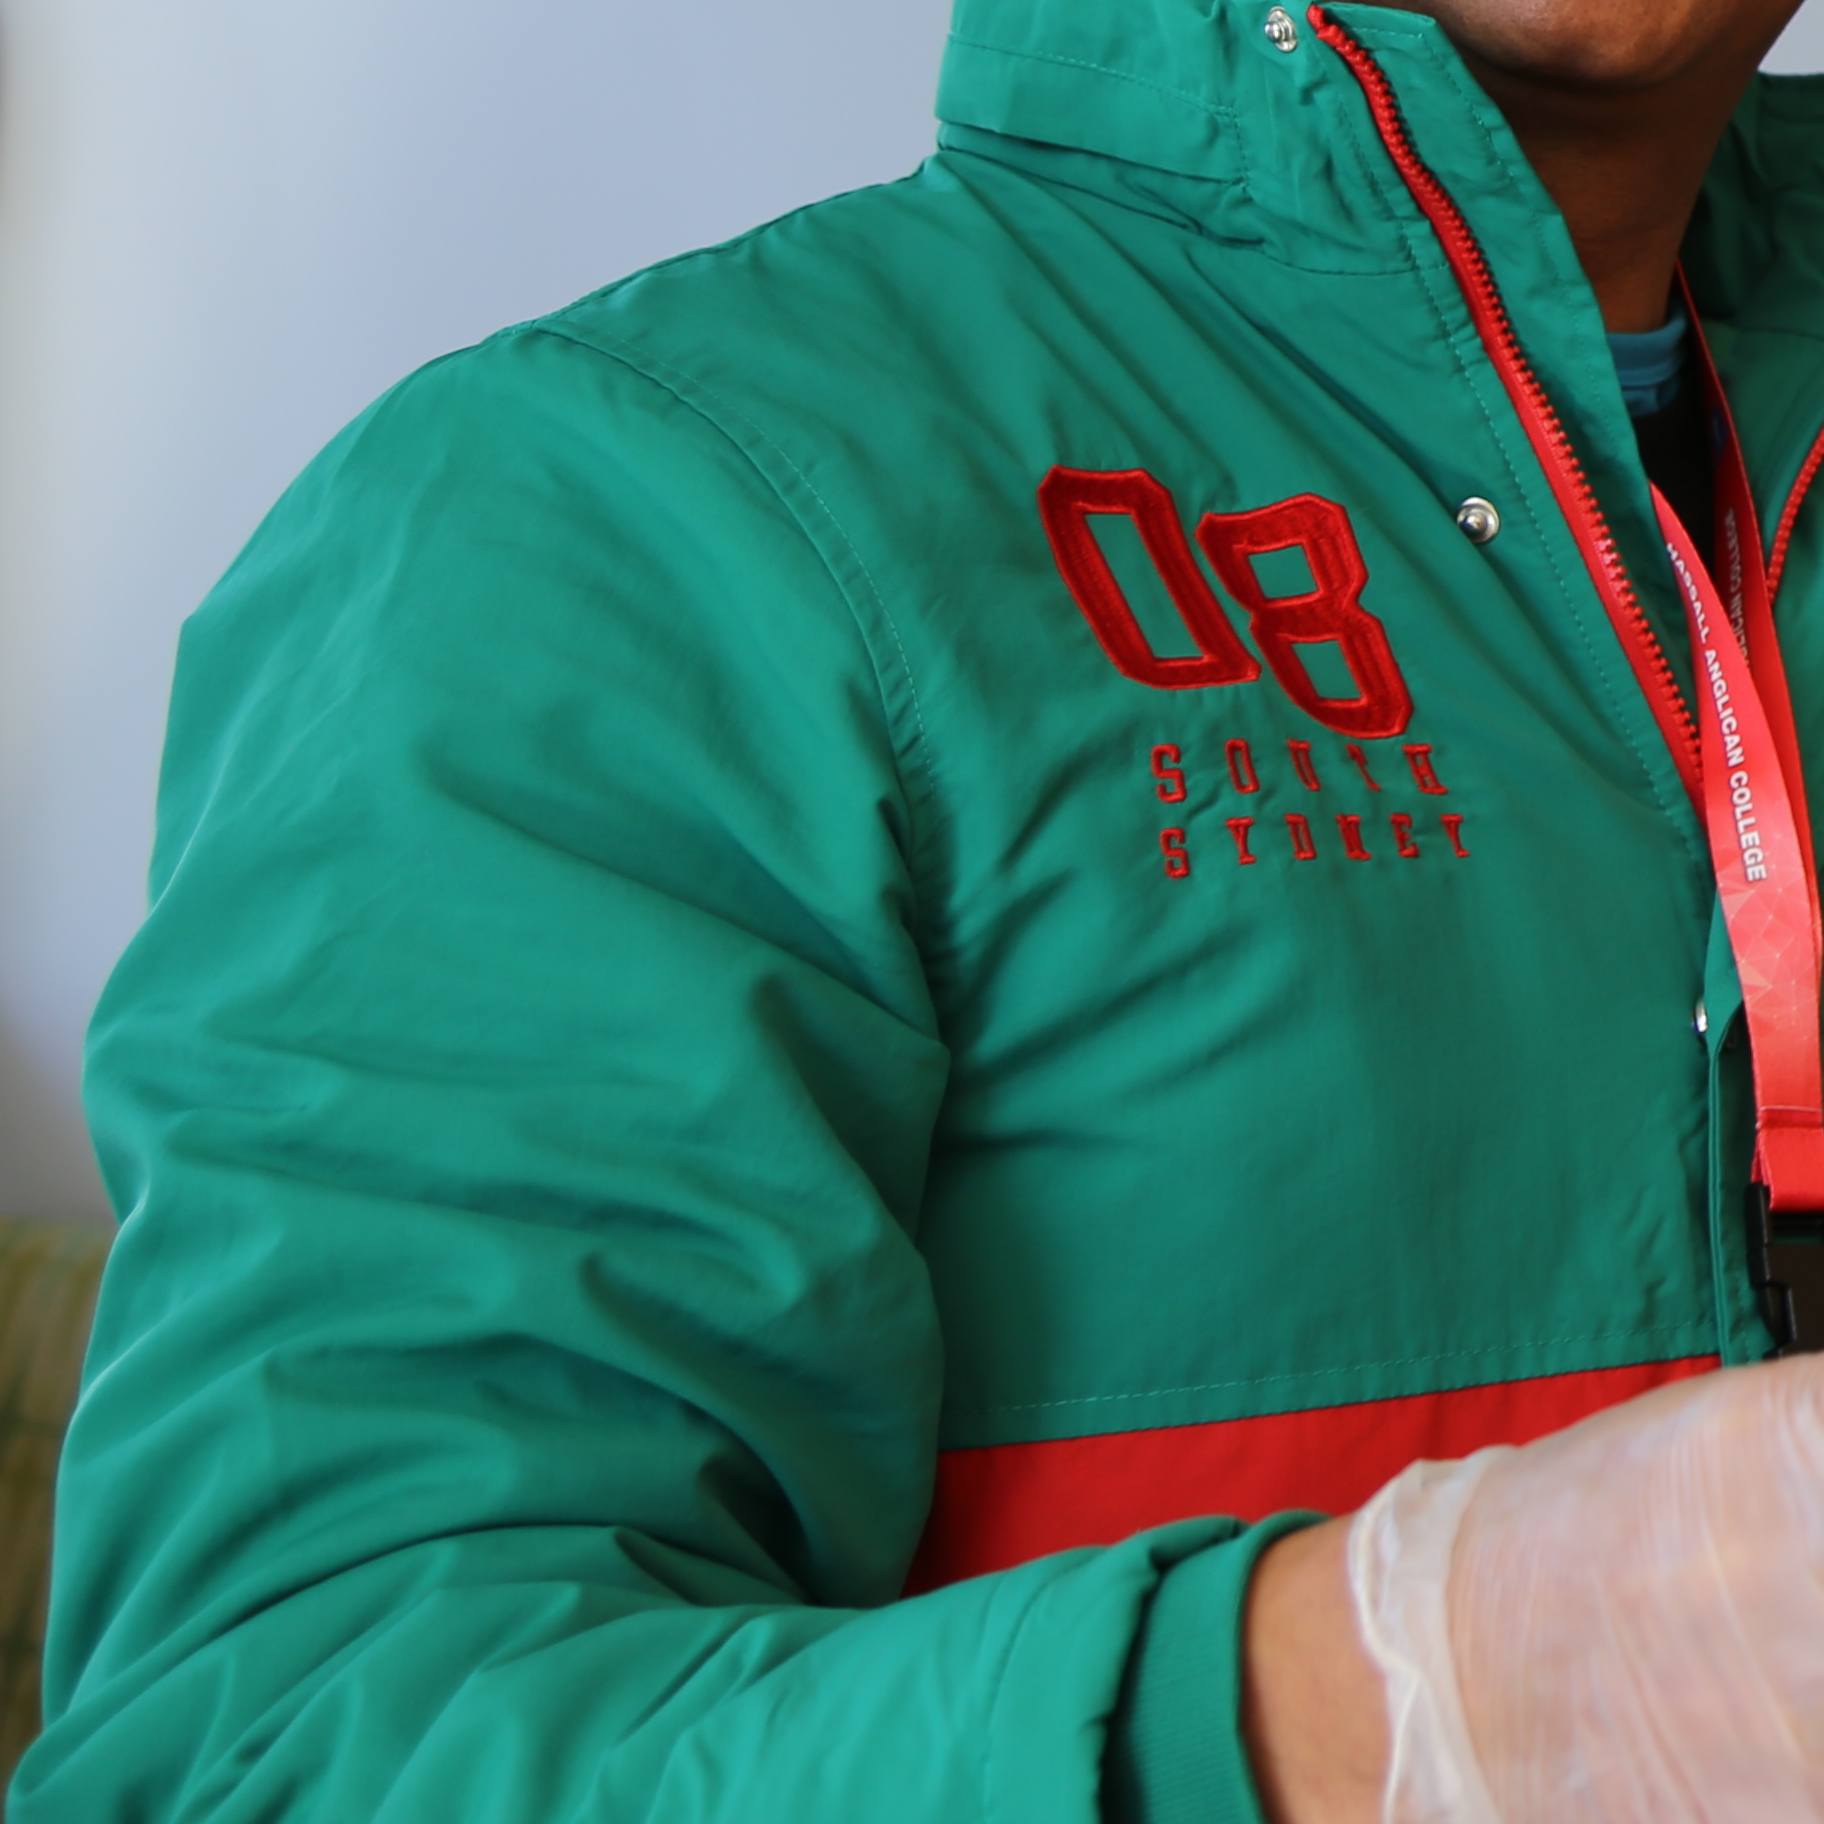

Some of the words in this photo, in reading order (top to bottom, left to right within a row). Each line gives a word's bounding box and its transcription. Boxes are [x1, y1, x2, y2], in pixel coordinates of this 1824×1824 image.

[1037, 464, 1414, 739] 08
[1666, 542, 1710, 645] HASSALL
[1705, 648, 1746, 768] ANGLICAN
[1729, 771, 1767, 882] COLLEGE
[1159, 813, 1471, 880] SYDNEY
